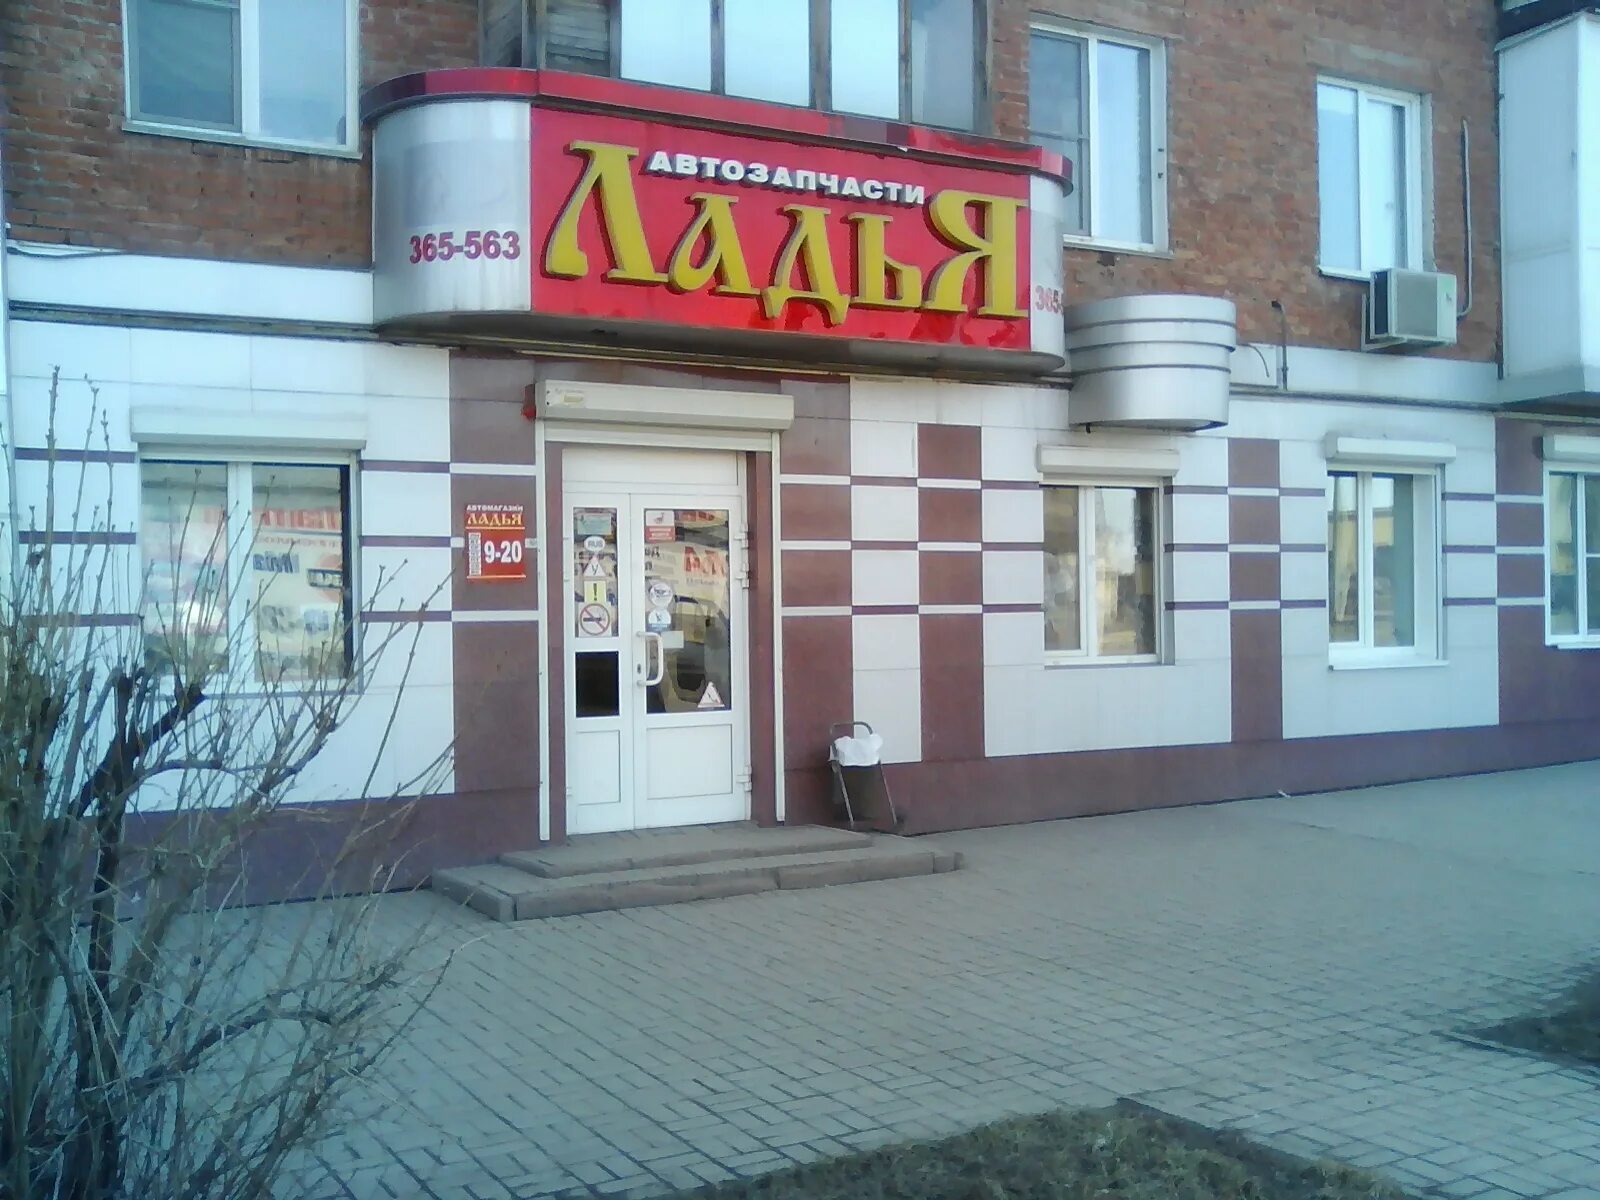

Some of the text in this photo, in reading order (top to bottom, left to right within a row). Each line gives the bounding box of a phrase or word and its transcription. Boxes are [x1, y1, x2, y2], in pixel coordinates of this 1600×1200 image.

[647, 150, 926, 206] АВТОЗАПЧАСТИ
[409, 229, 521, 264] 365-563
[467, 513, 522, 526] ЛАДЬЯ
[484, 540, 522, 563] 9-20
[587, 540, 604, 548] RUS
